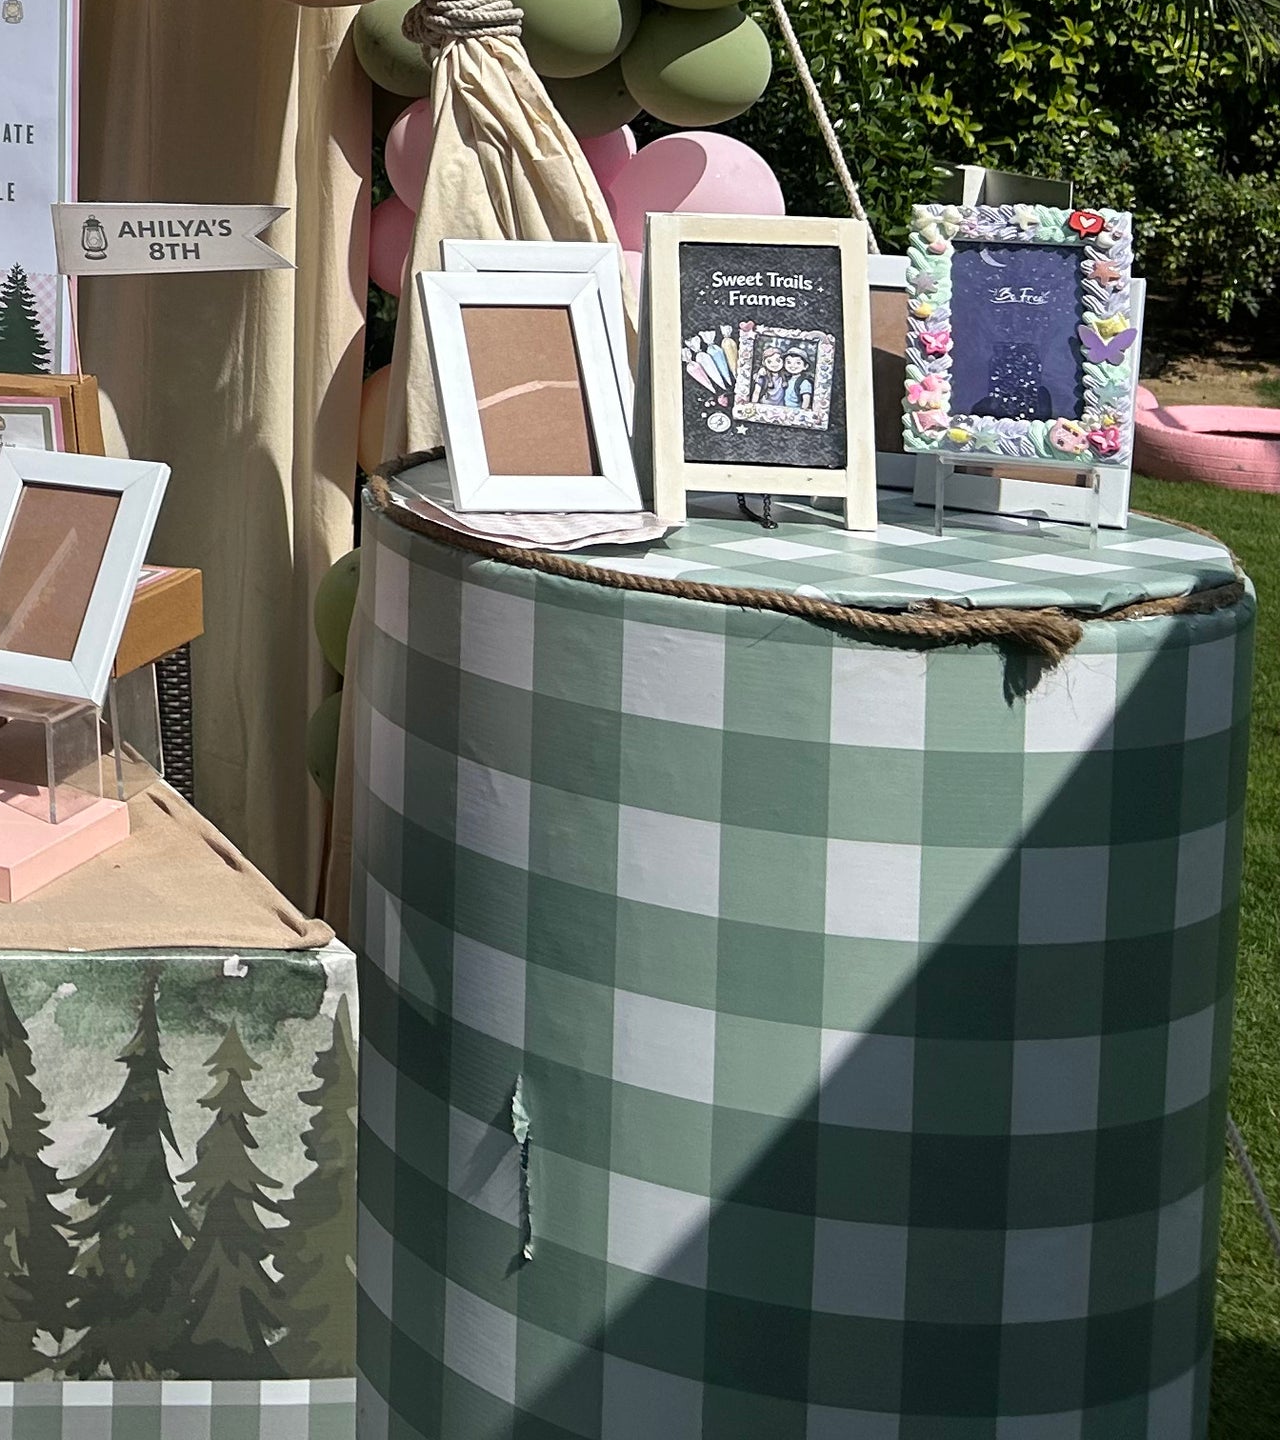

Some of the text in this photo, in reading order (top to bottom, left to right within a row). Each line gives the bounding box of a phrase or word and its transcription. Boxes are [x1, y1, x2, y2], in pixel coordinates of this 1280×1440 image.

[118, 219, 232, 238] AHILYA'S
[149, 242, 200, 260] 8TH
[712, 271, 813, 290] Sweet Trails
[729, 290, 796, 307] Frames
